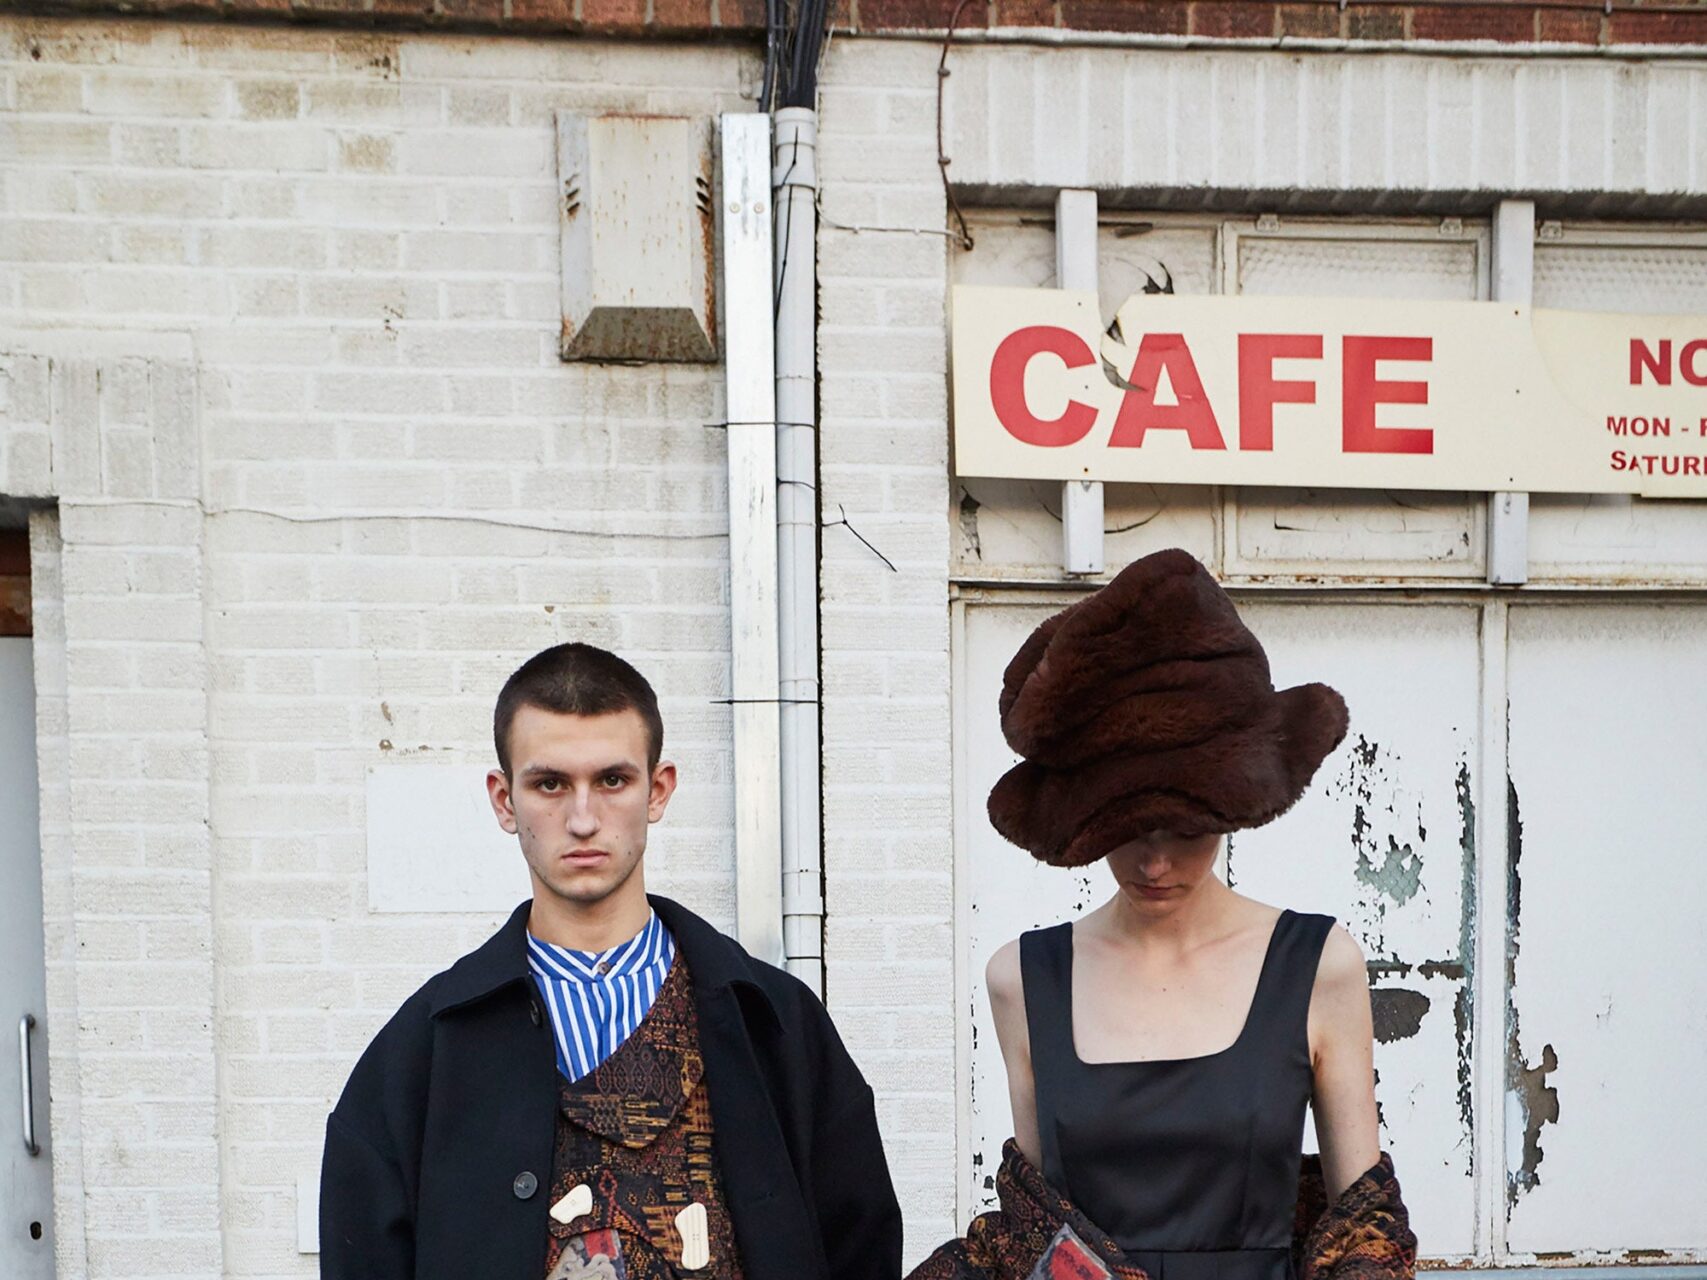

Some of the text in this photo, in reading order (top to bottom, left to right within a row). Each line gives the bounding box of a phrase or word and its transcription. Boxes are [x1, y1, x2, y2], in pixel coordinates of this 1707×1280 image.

[989, 324, 1435, 456] CAFE
[1606, 415, 1671, 437] MON
[1610, 450, 1707, 477] SATUR
